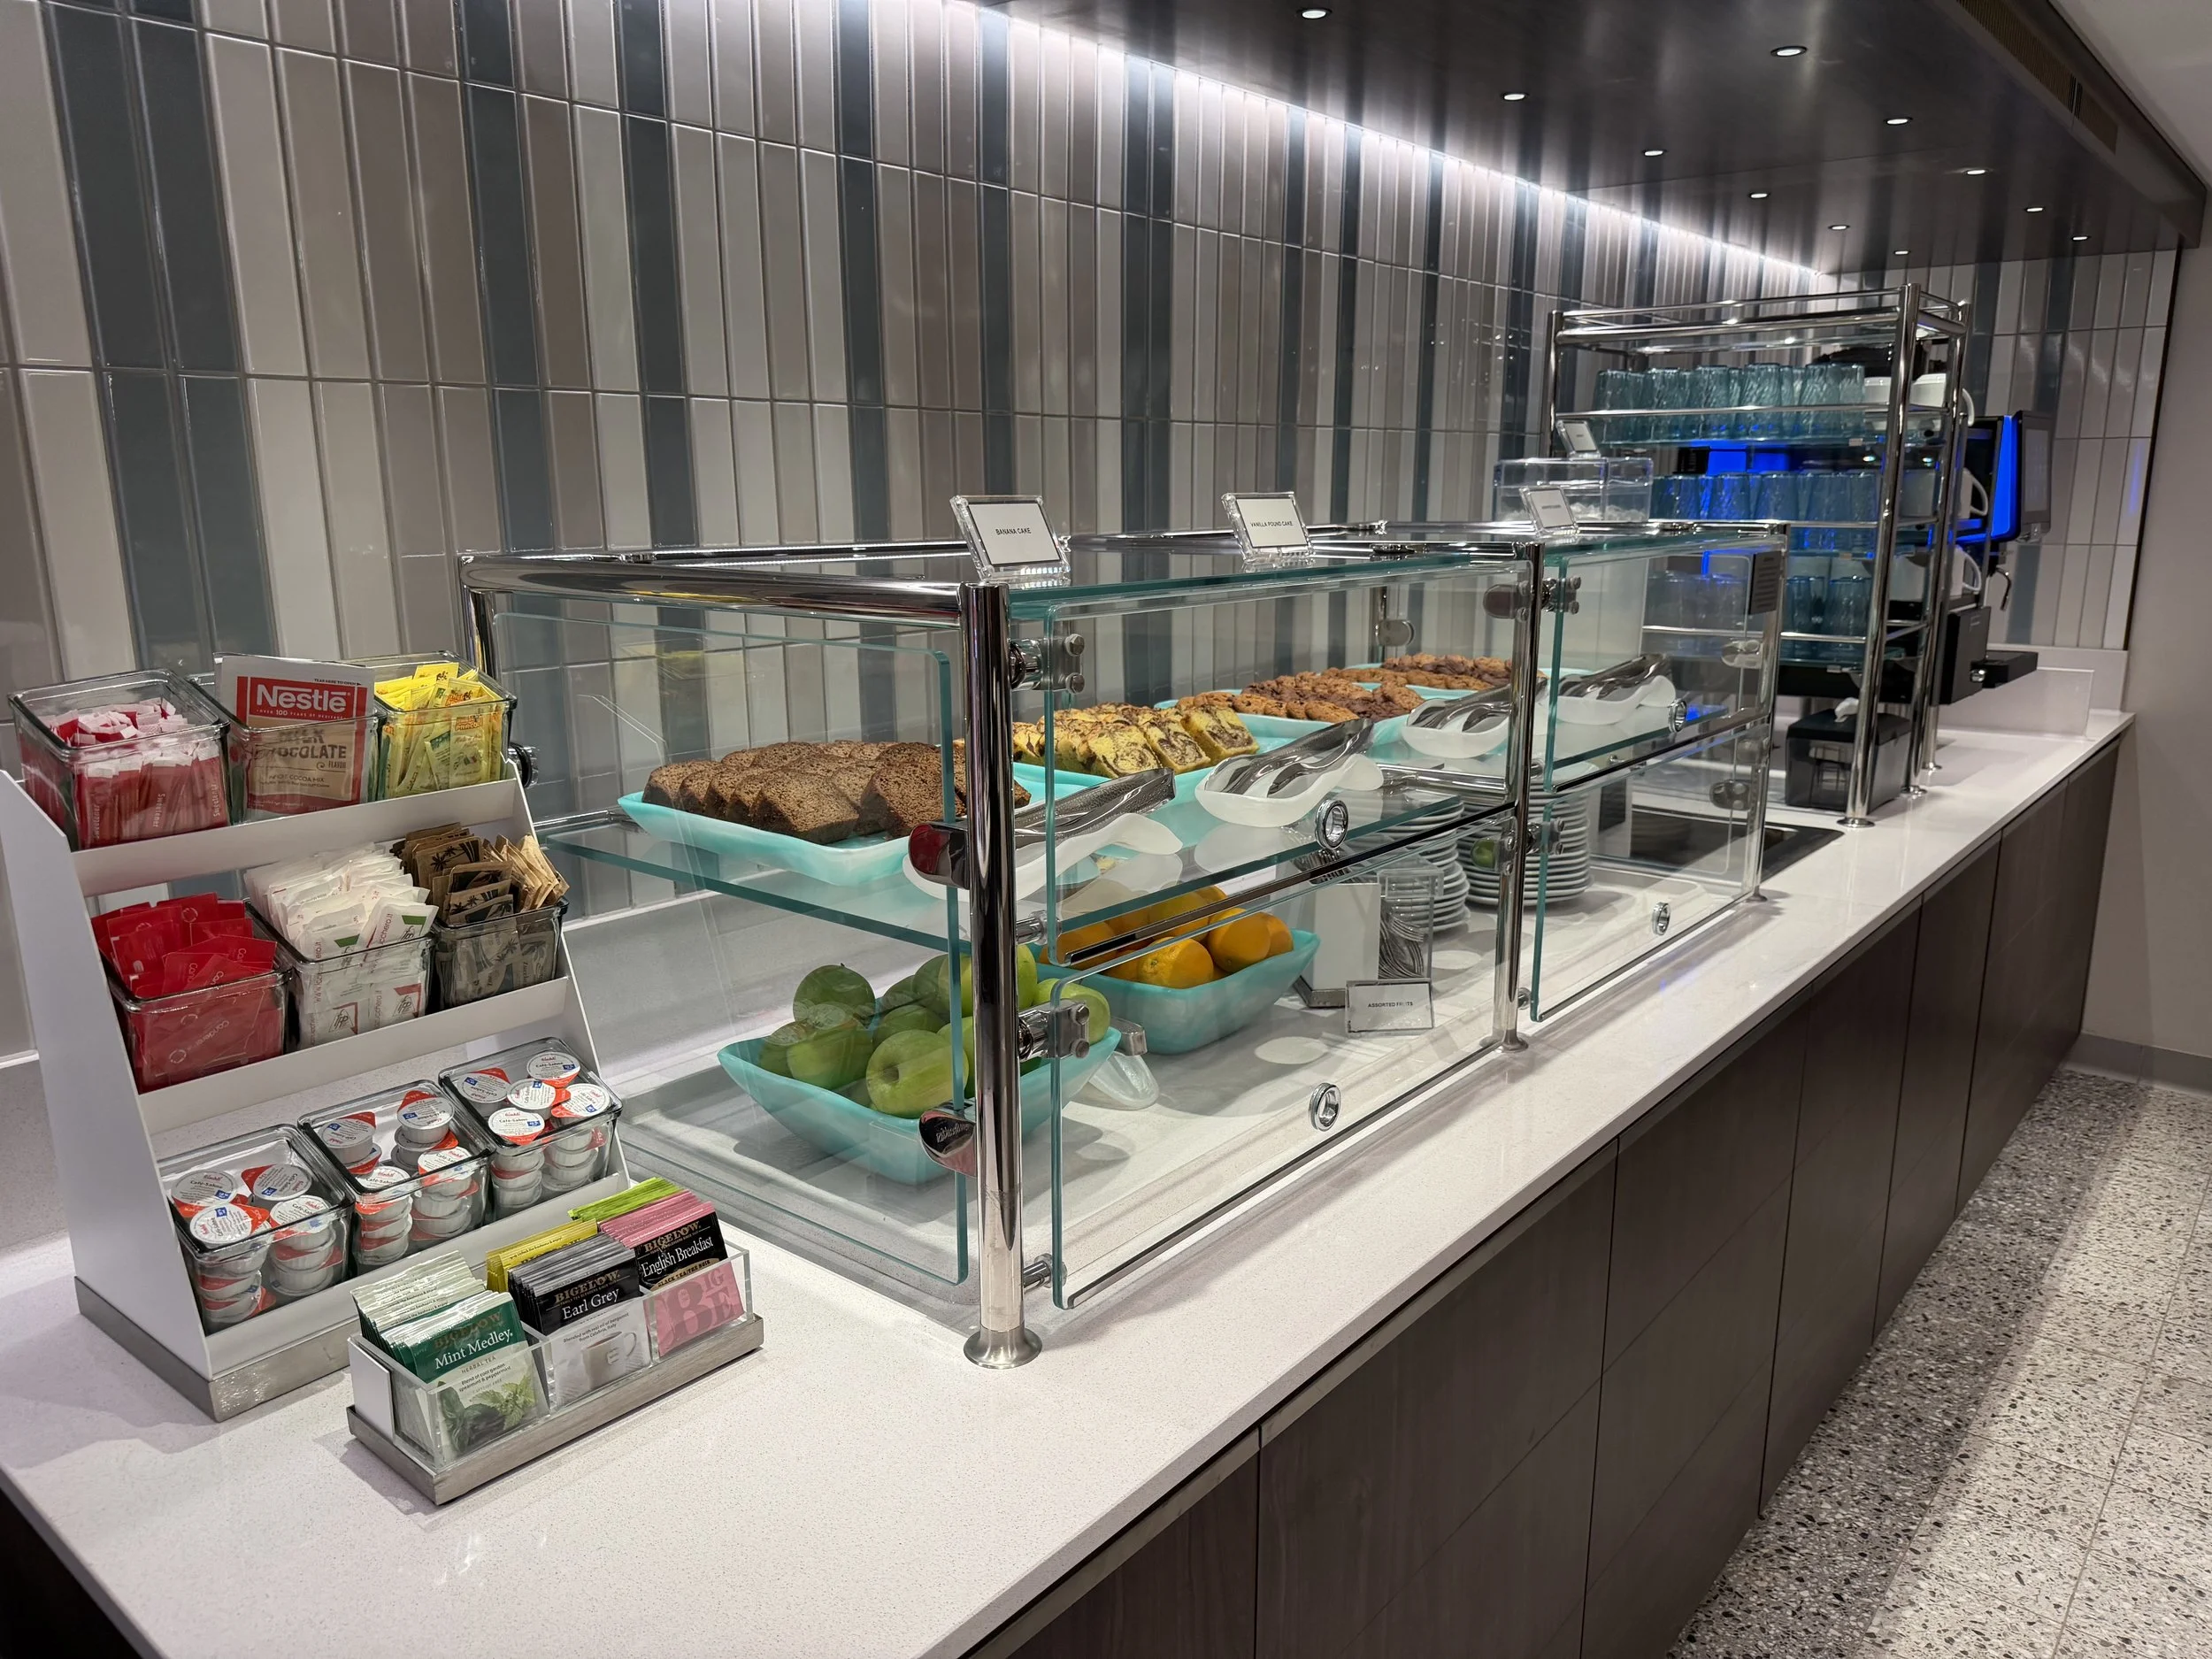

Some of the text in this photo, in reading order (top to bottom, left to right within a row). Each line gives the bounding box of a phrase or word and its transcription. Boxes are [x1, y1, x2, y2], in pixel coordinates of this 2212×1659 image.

[152, 793, 166, 828] Sweetener
[644, 1221, 702, 1253] BIGELOW
[641, 1252, 676, 1278] English
[675, 1236, 714, 1262] Breakfast
[555, 1269, 620, 1304] BIGELOW
[562, 1299, 588, 1320] Earl
[590, 1288, 619, 1308] Grey
[435, 1348, 467, 1370] Mint
[461, 1355, 496, 1374] HERBAL TEA
